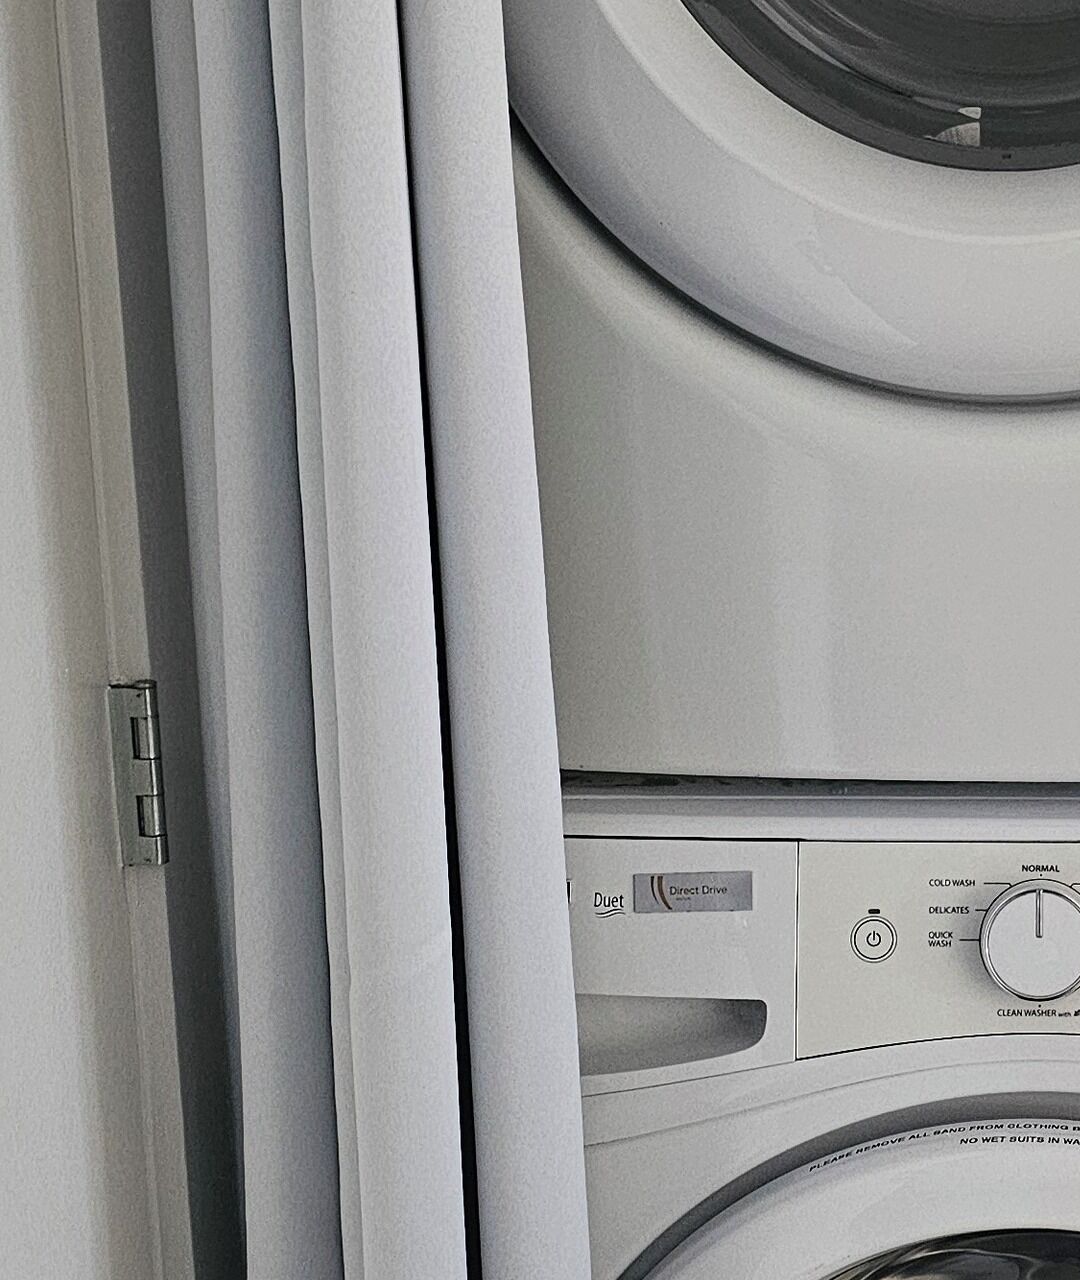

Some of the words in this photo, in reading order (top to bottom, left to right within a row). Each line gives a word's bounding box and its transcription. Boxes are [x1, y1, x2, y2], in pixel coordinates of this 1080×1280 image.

[1021, 864, 1060, 873] NORMAL
[928, 879, 950, 887] COLD
[951, 879, 976, 887] WASH
[669, 885, 699, 895] Direct
[701, 885, 728, 895] Drive
[593, 892, 624, 908] Duet
[928, 906, 970, 914] DELICATES
[928, 931, 953, 940] QUICK
[928, 940, 952, 948] WASH
[997, 1008, 1023, 1017] CLEAN
[1023, 1009, 1057, 1017] WASHER
[959, 1137, 978, 1145] NO
[981, 1135, 1006, 1143] WET
[1009, 1135, 1045, 1143] SUITS
[1048, 1136, 1060, 1144] IN
[809, 1151, 852, 1172] PLEASE
[855, 1137, 905, 1154] REMOVE
[908, 1132, 931, 1140] ALL
[933, 1126, 966, 1136] SAND
[968, 1123, 1004, 1131] FROM
[1007, 1123, 1068, 1131] CLOTHING
